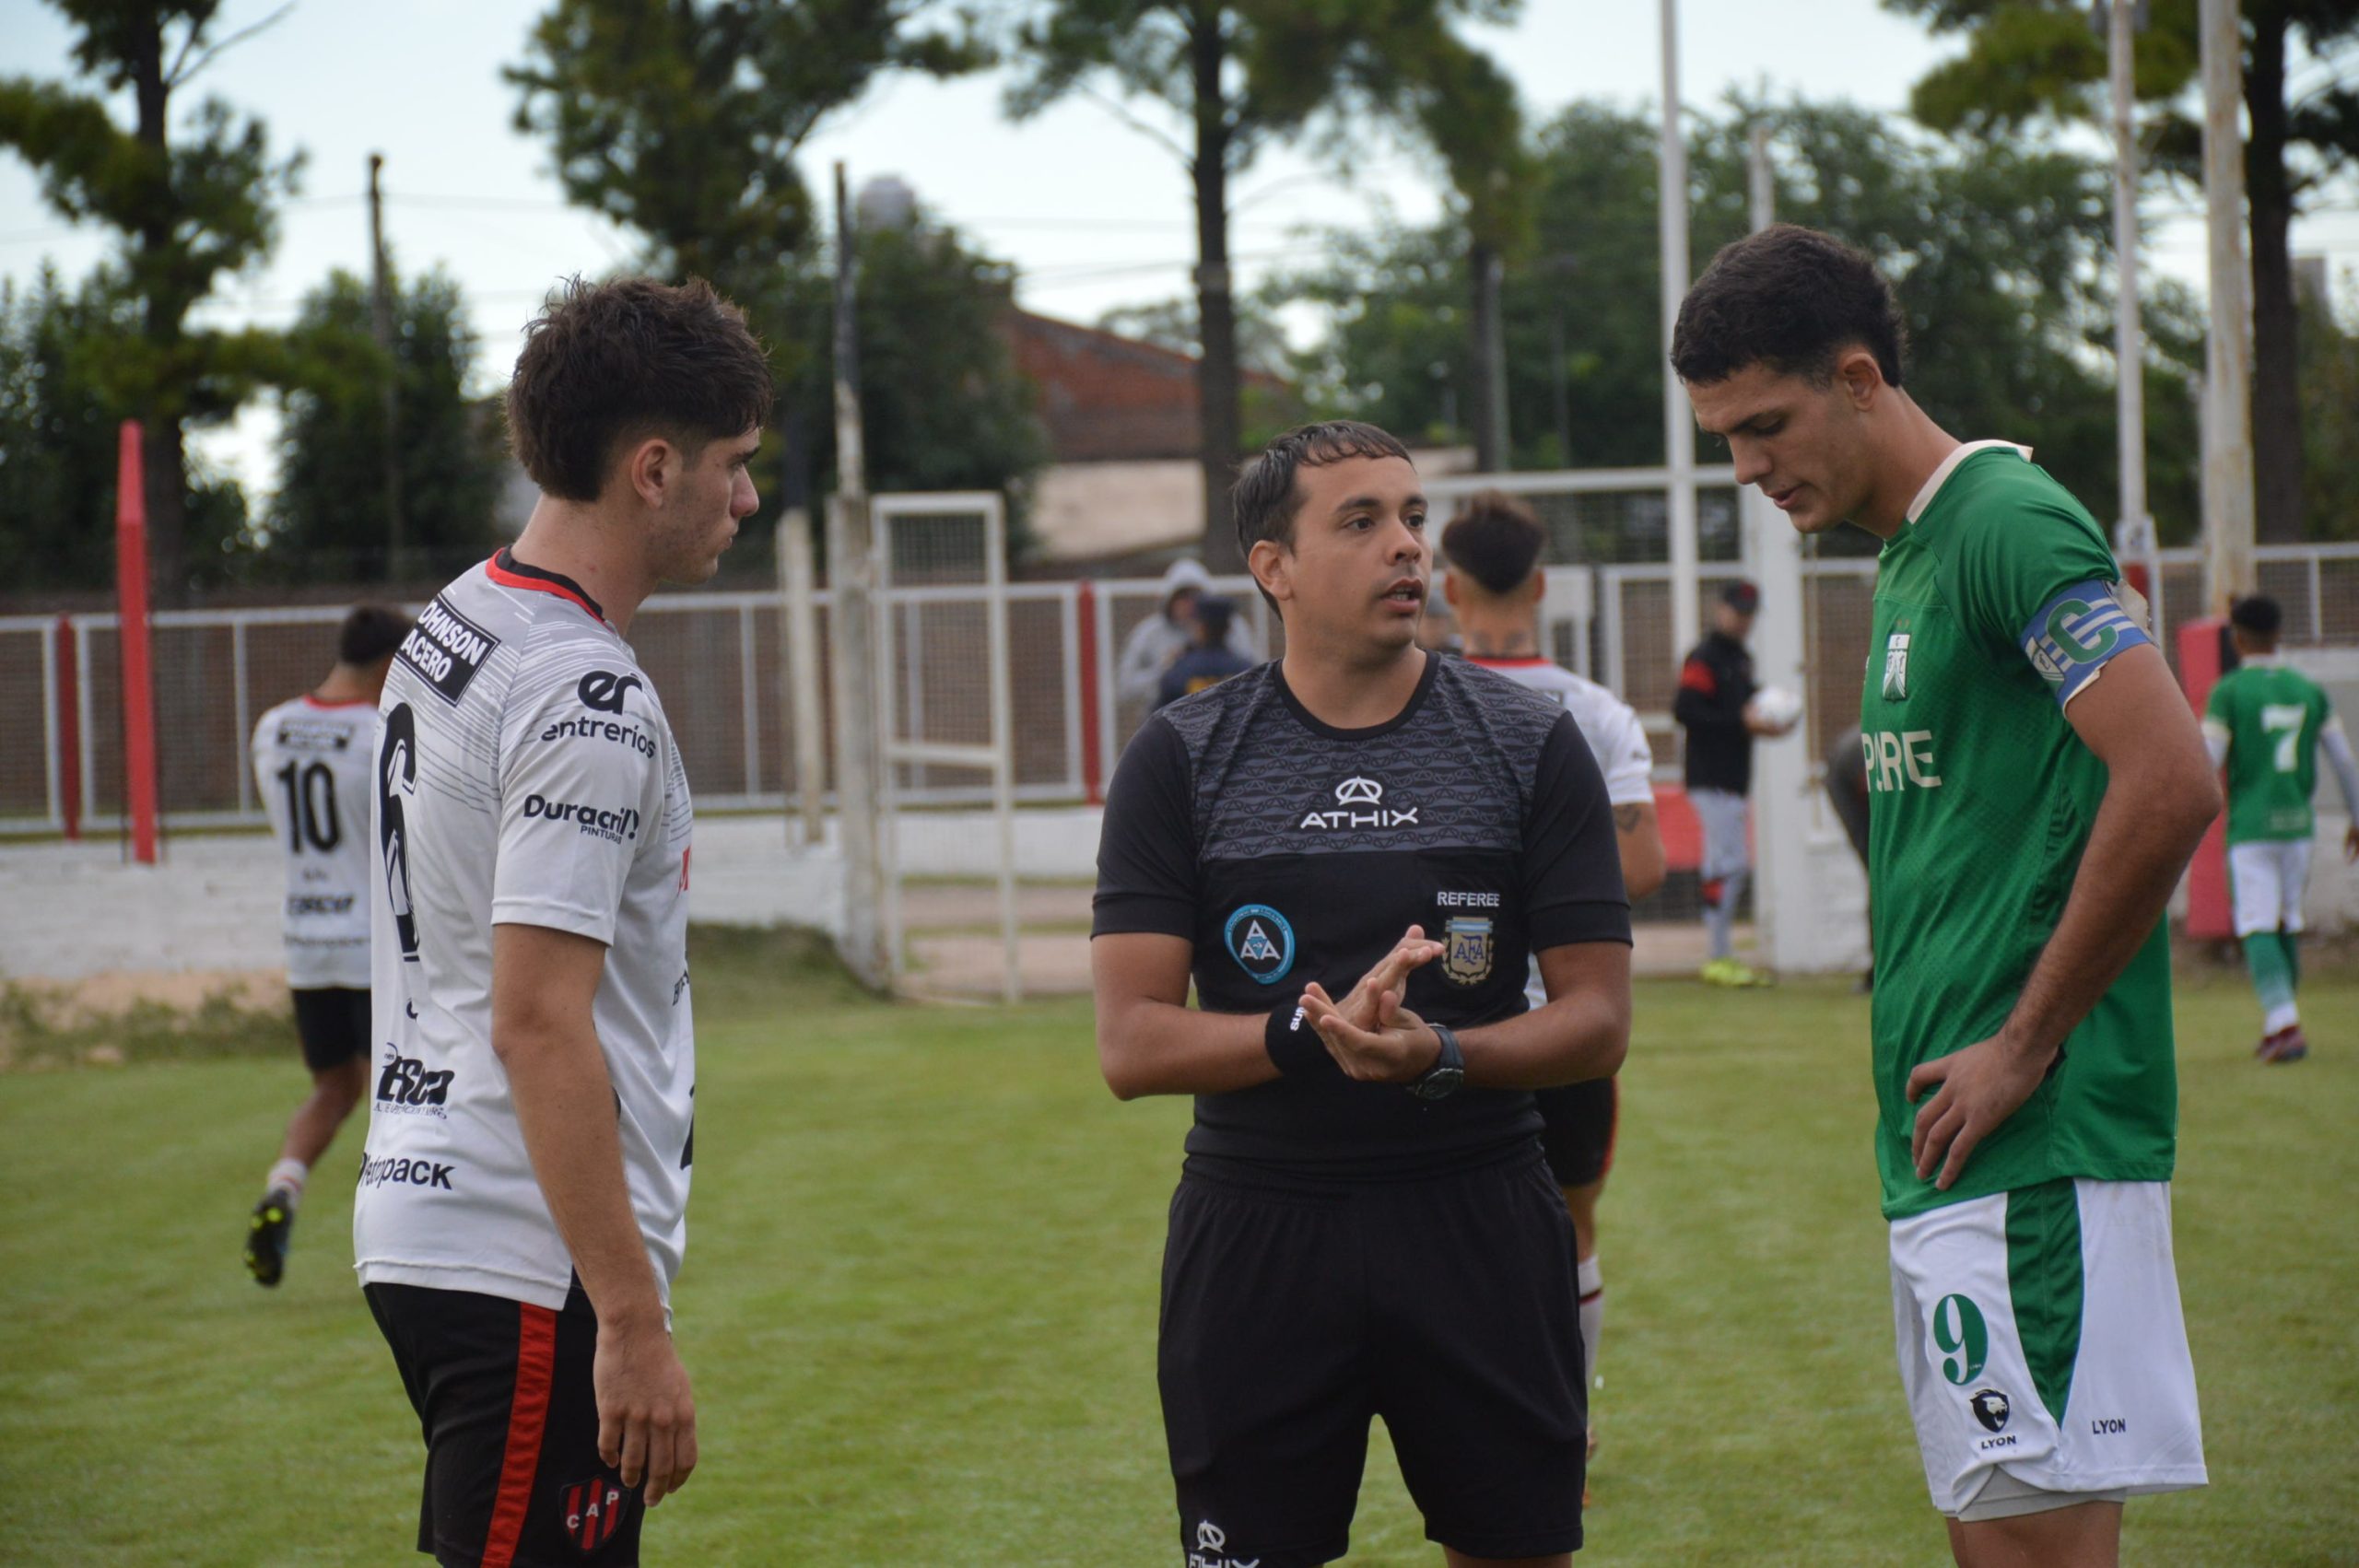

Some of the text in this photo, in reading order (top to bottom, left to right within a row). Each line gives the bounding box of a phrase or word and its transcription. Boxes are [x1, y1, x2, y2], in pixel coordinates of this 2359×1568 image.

[400, 628, 452, 682] ACERO
[417, 601, 488, 666] OHNSON
[2047, 598, 2119, 664] C
[2261, 703, 2306, 772] 7
[277, 757, 343, 855] 10
[1300, 807, 1418, 829] ATHIX
[1438, 891, 1500, 907] REFEREE
[1933, 1293, 1989, 1386] 9
[1981, 1434, 2017, 1450] LYON
[2092, 1419, 2126, 1434] LYON
